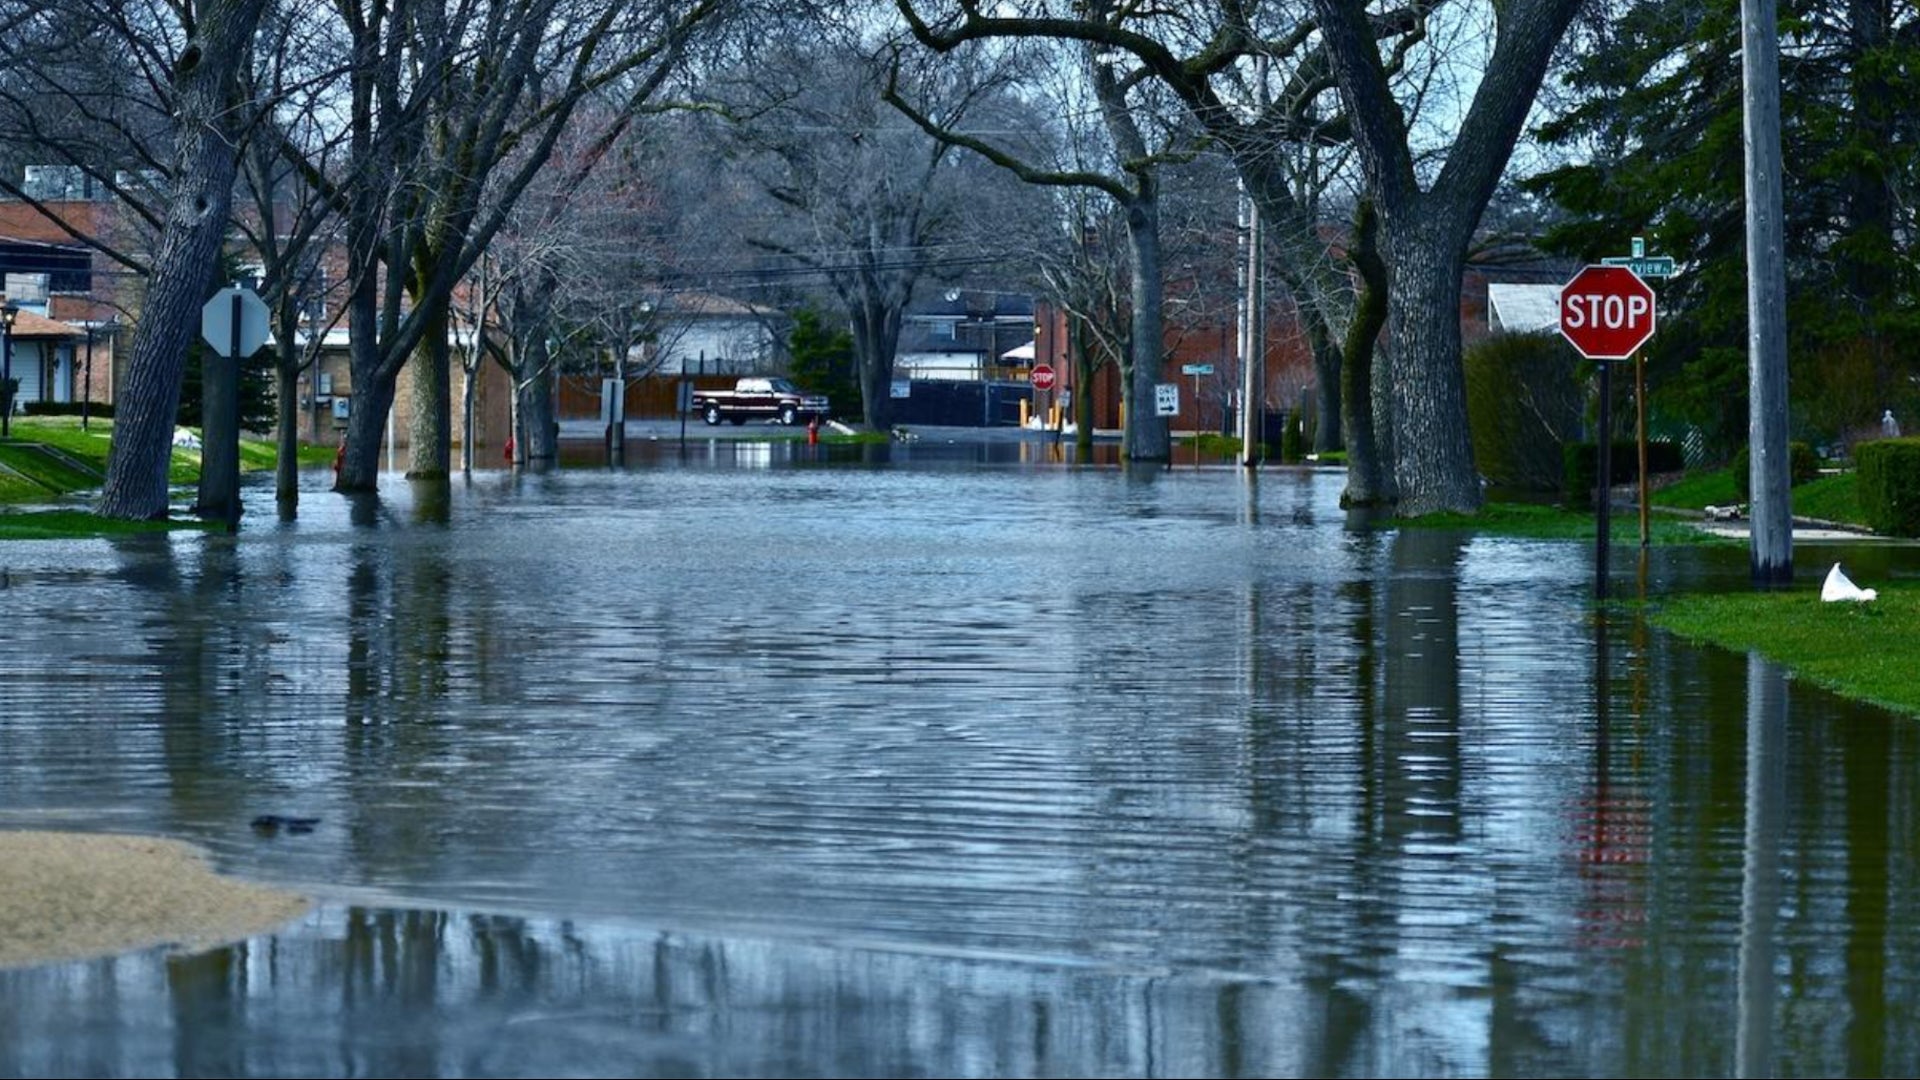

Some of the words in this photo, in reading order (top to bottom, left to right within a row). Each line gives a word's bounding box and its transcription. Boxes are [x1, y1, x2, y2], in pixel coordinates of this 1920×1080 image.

[1565, 294, 1648, 329] STOP
[1032, 372, 1053, 383] STOP
[1158, 387, 1175, 396] ONE
[1159, 396, 1175, 404] WAY
